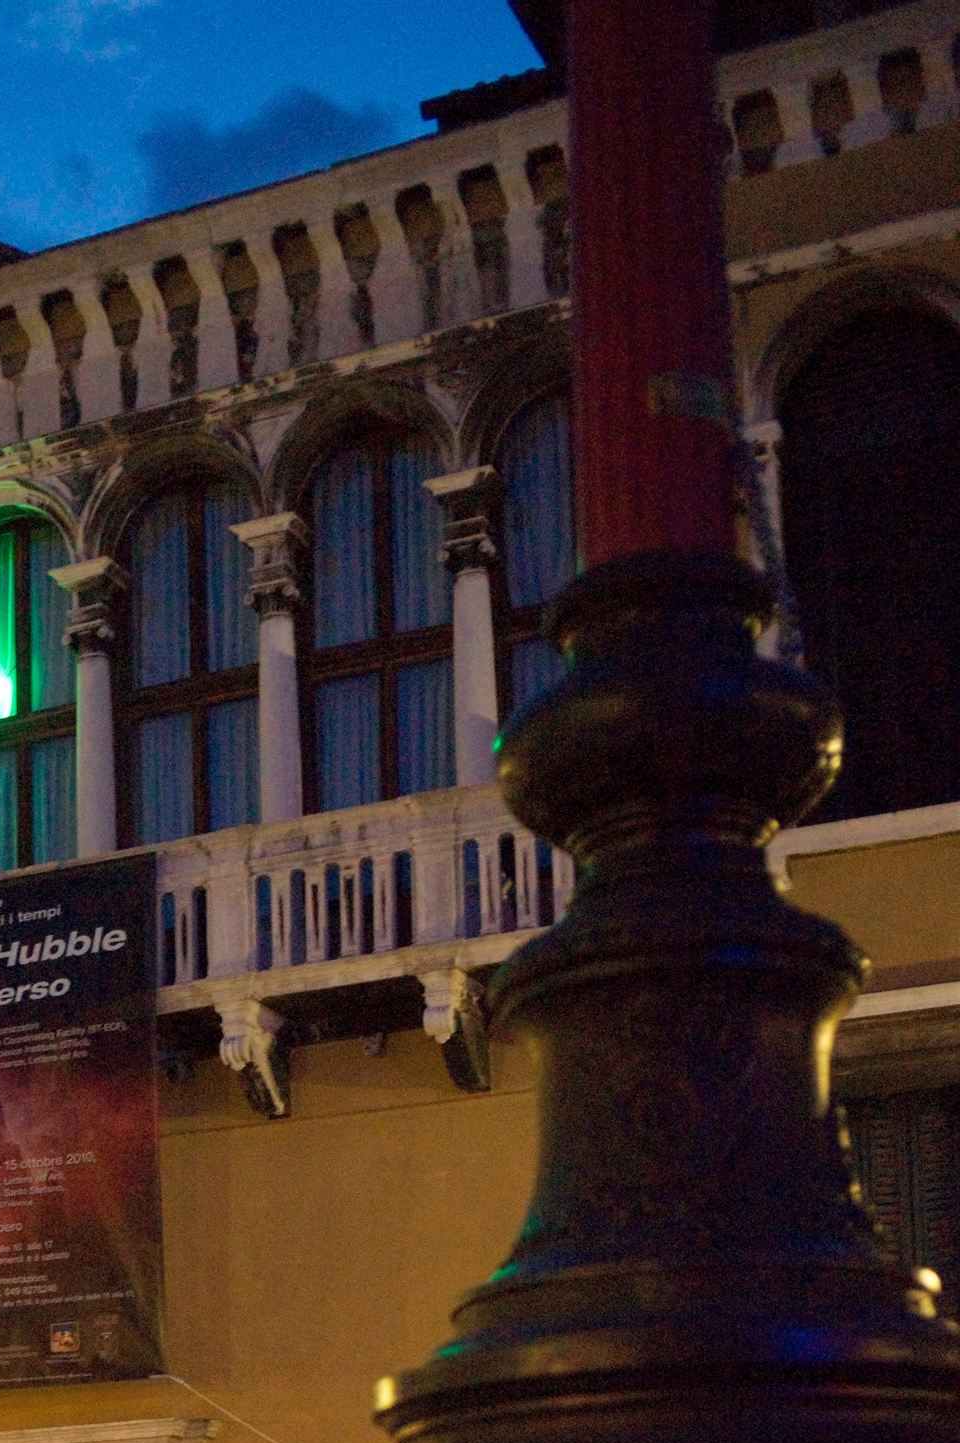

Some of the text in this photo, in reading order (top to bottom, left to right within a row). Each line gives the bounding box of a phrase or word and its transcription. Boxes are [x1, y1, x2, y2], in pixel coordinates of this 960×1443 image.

[9, 911, 14, 924] i
[18, 903, 62, 924] tempi
[3, 1159, 18, 1171] 15
[20, 1155, 63, 1169] ottobre
